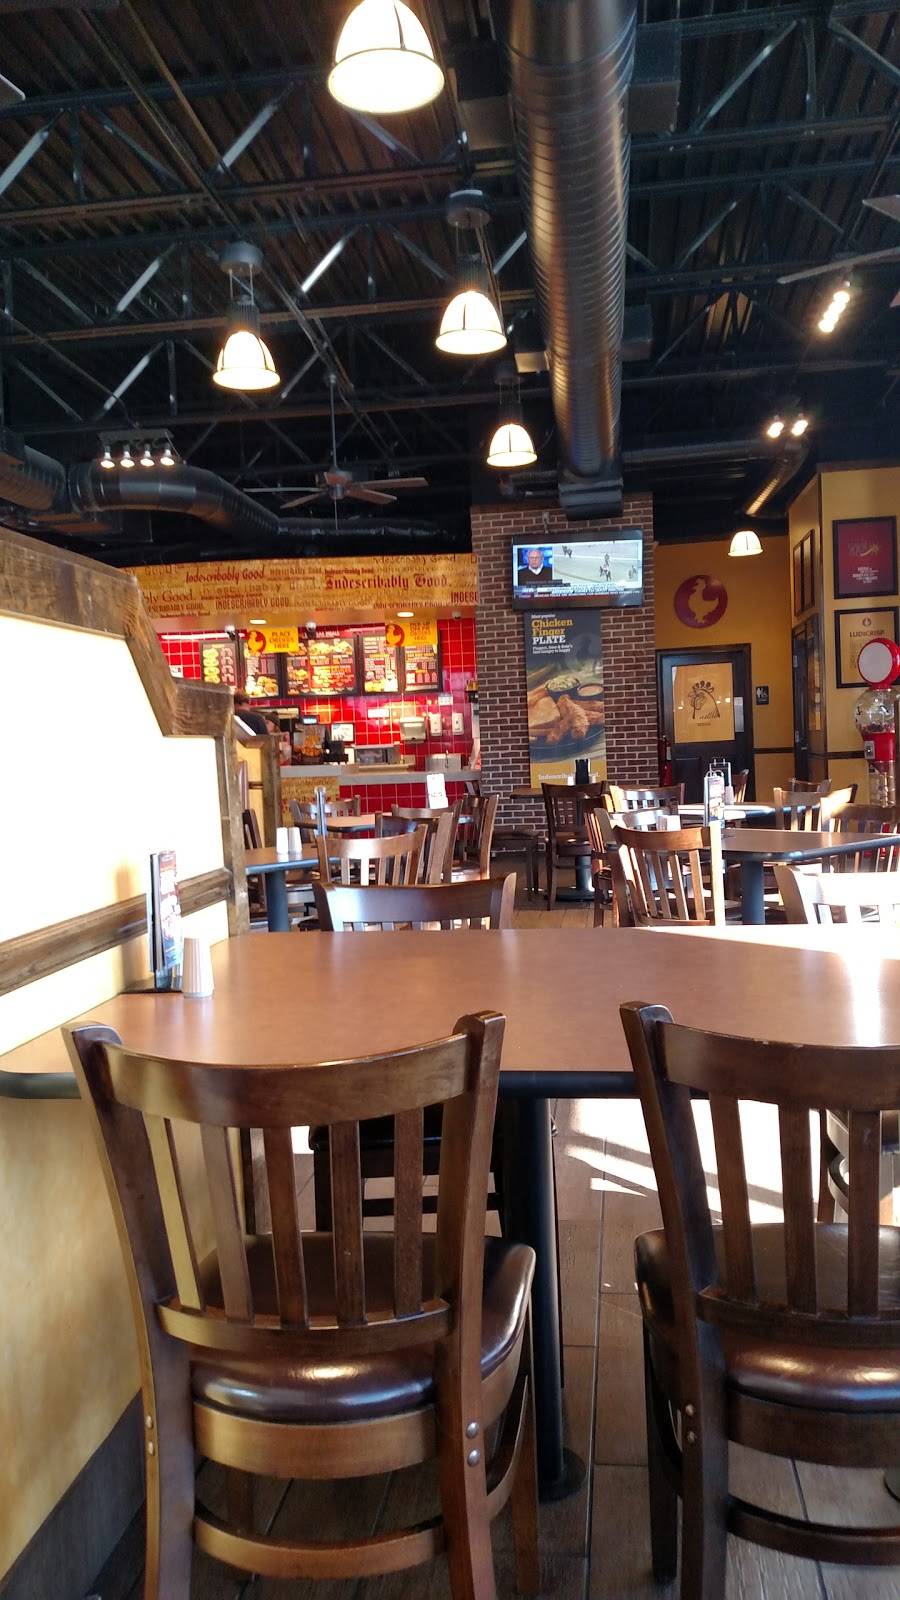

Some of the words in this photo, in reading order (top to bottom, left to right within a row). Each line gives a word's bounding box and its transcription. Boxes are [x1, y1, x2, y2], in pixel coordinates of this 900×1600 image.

[186, 566, 240, 585] Indescribably
[242, 563, 265, 580] Good
[325, 575, 409, 591] Indescribably
[531, 618, 574, 629] Chicken
[532, 627, 566, 638] Finger
[532, 635, 566, 645] PLATE
